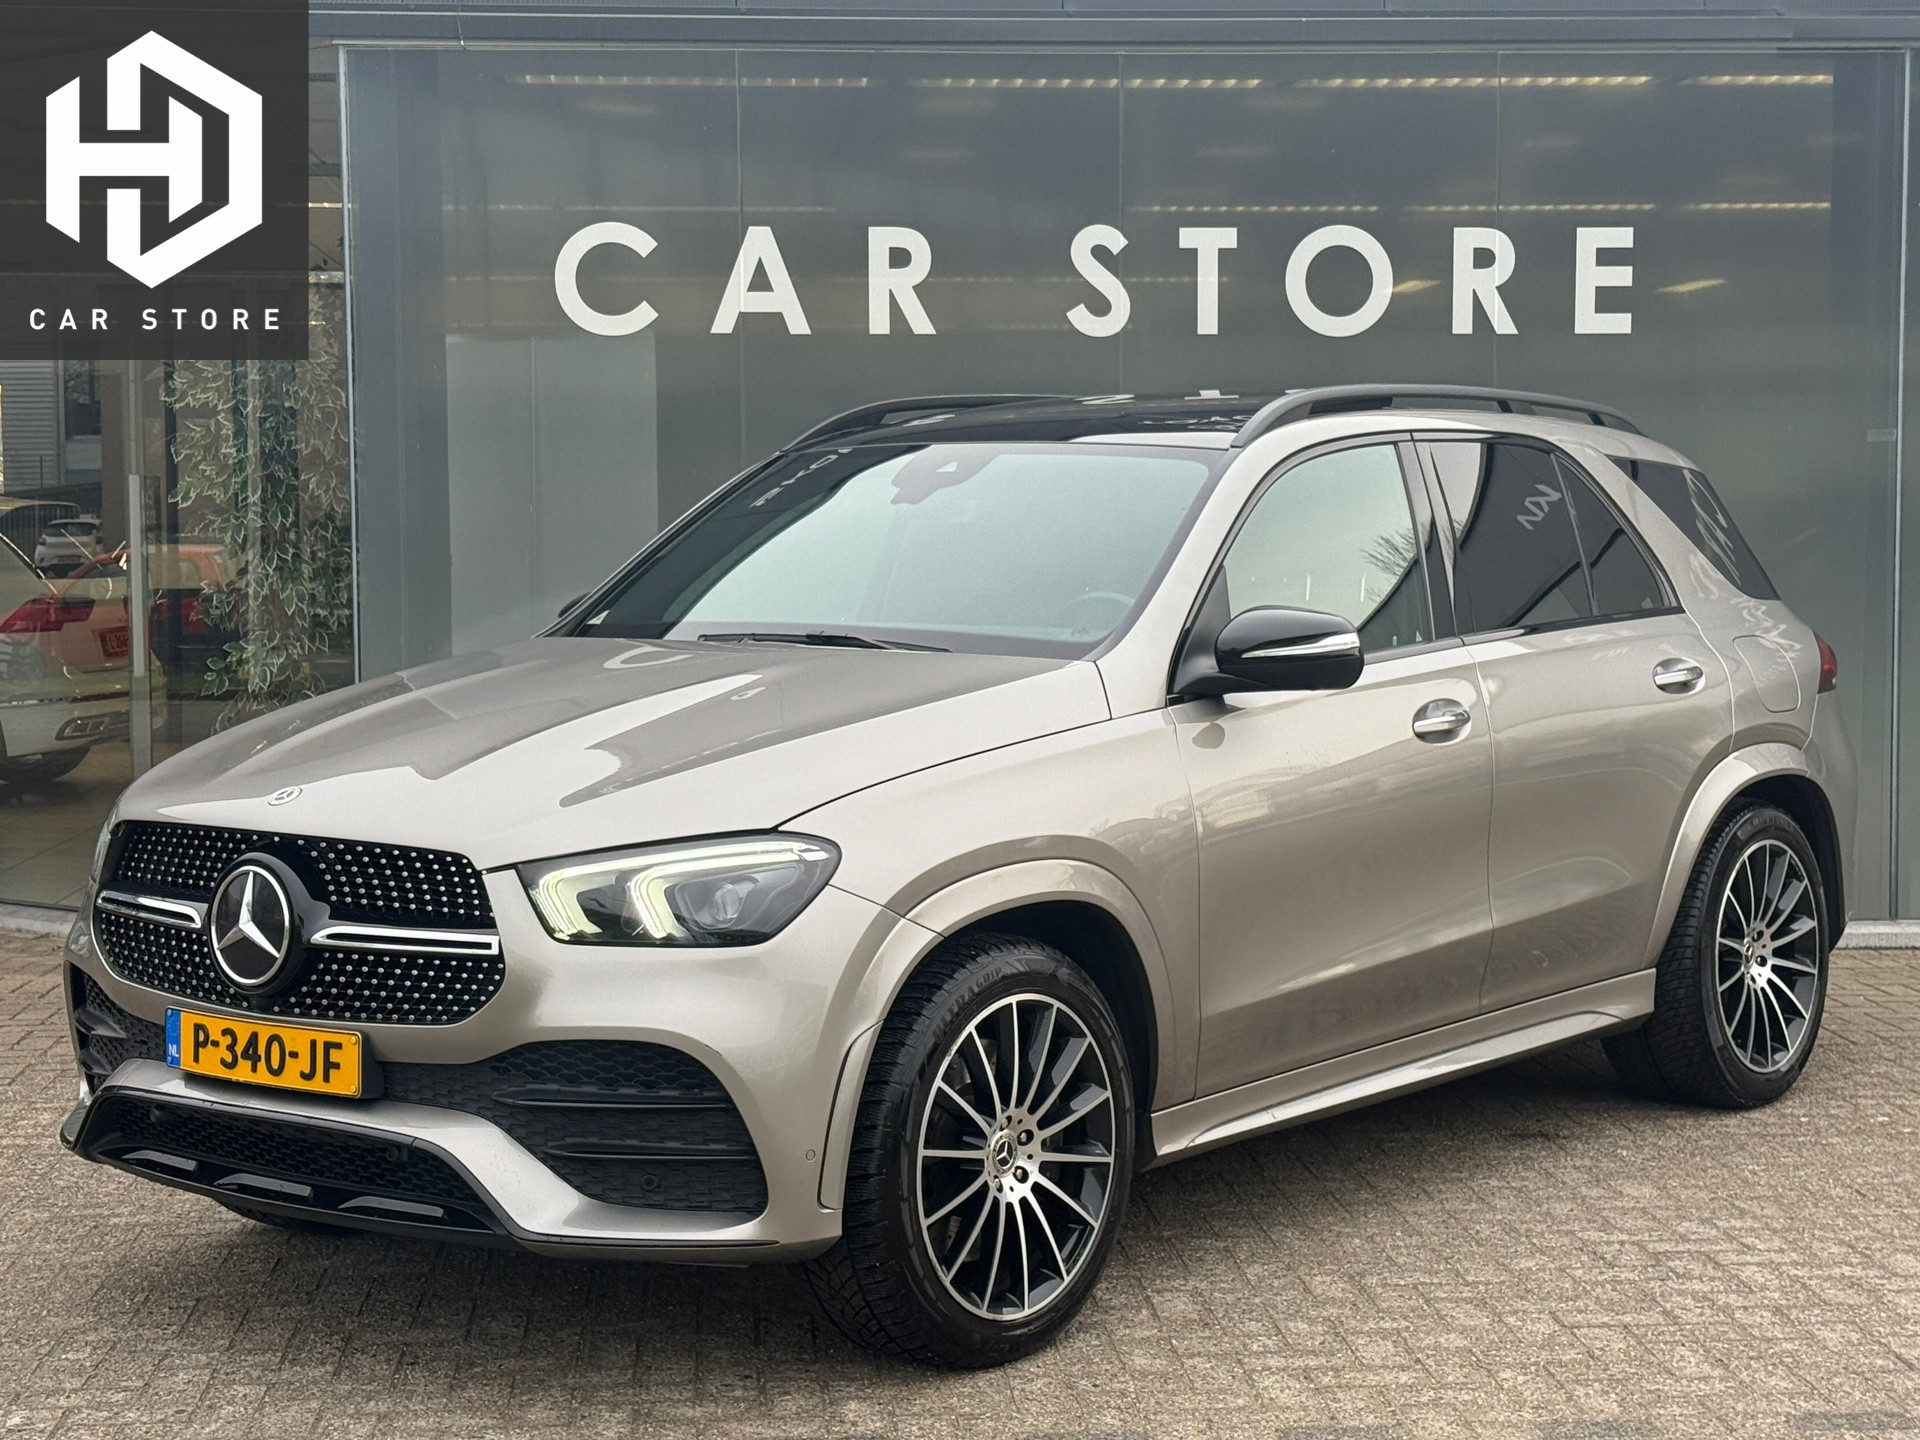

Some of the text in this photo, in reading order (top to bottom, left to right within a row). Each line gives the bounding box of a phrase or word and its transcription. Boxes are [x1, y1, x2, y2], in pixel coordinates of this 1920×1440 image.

[555, 222, 1633, 337] CAR STORE
[168, 1043, 179, 1058] NL
[193, 1022, 343, 1083] P-340-JF
